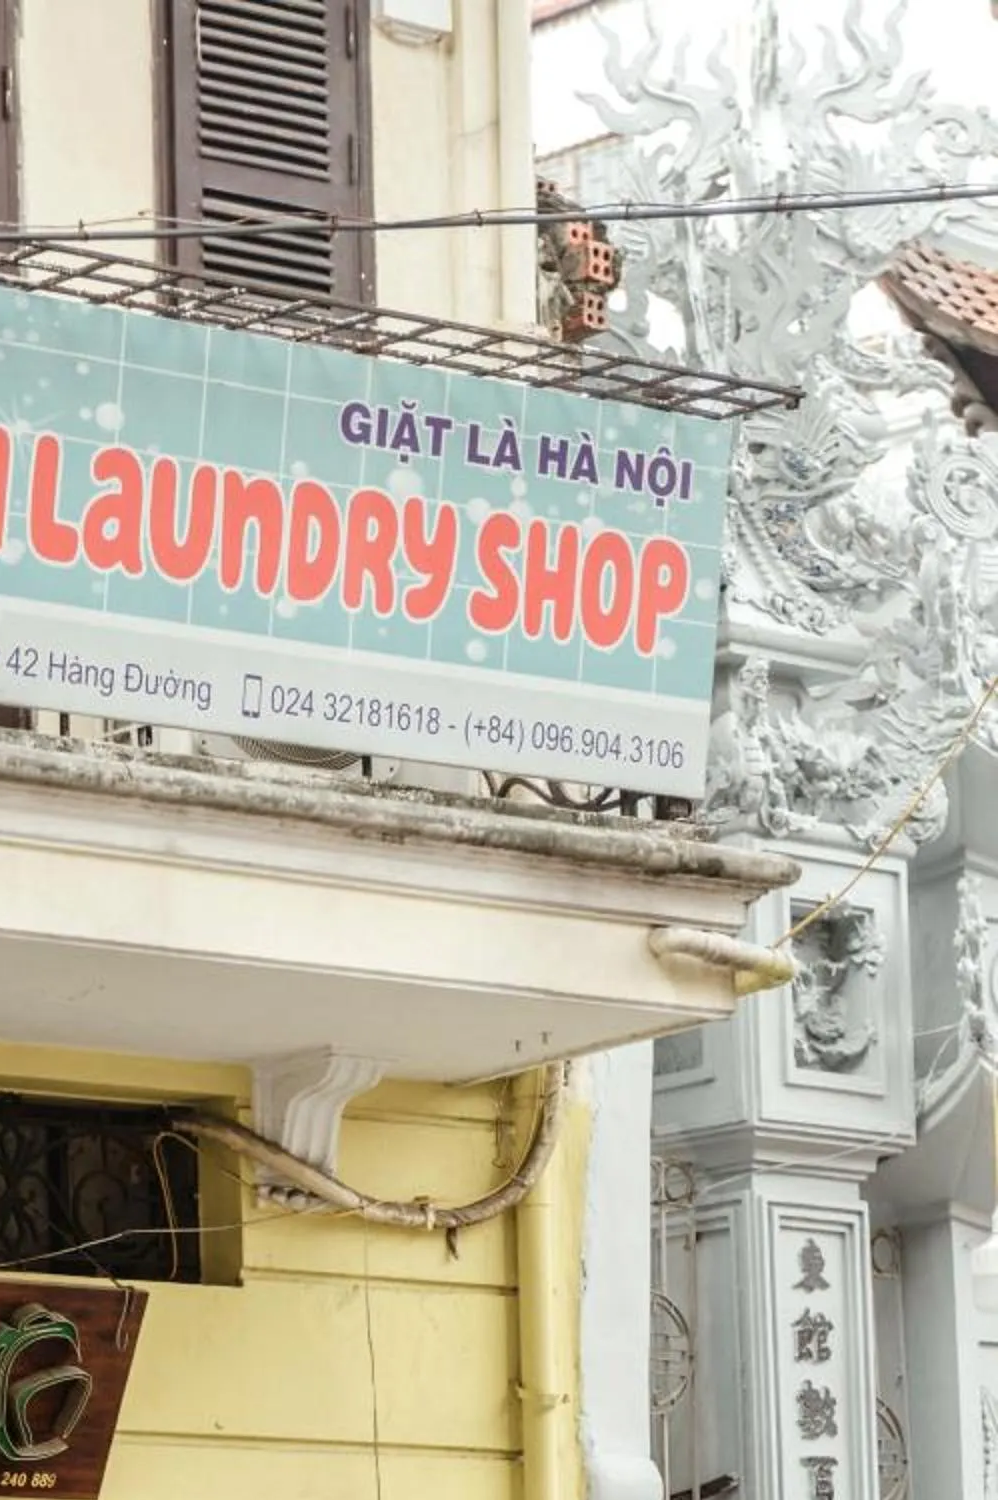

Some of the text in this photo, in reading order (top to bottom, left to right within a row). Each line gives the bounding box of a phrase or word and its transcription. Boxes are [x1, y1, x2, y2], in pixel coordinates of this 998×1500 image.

[340, 399, 693, 507] GIẶT LÀ HÀ NỘI
[469, 511, 690, 656] SHOP
[6, 647, 39, 677] 42
[270, 685, 314, 718] 024
[323, 692, 440, 735] 32181618
[464, 710, 525, 753] (+84)
[531, 721, 684, 769] 096.904.3106
